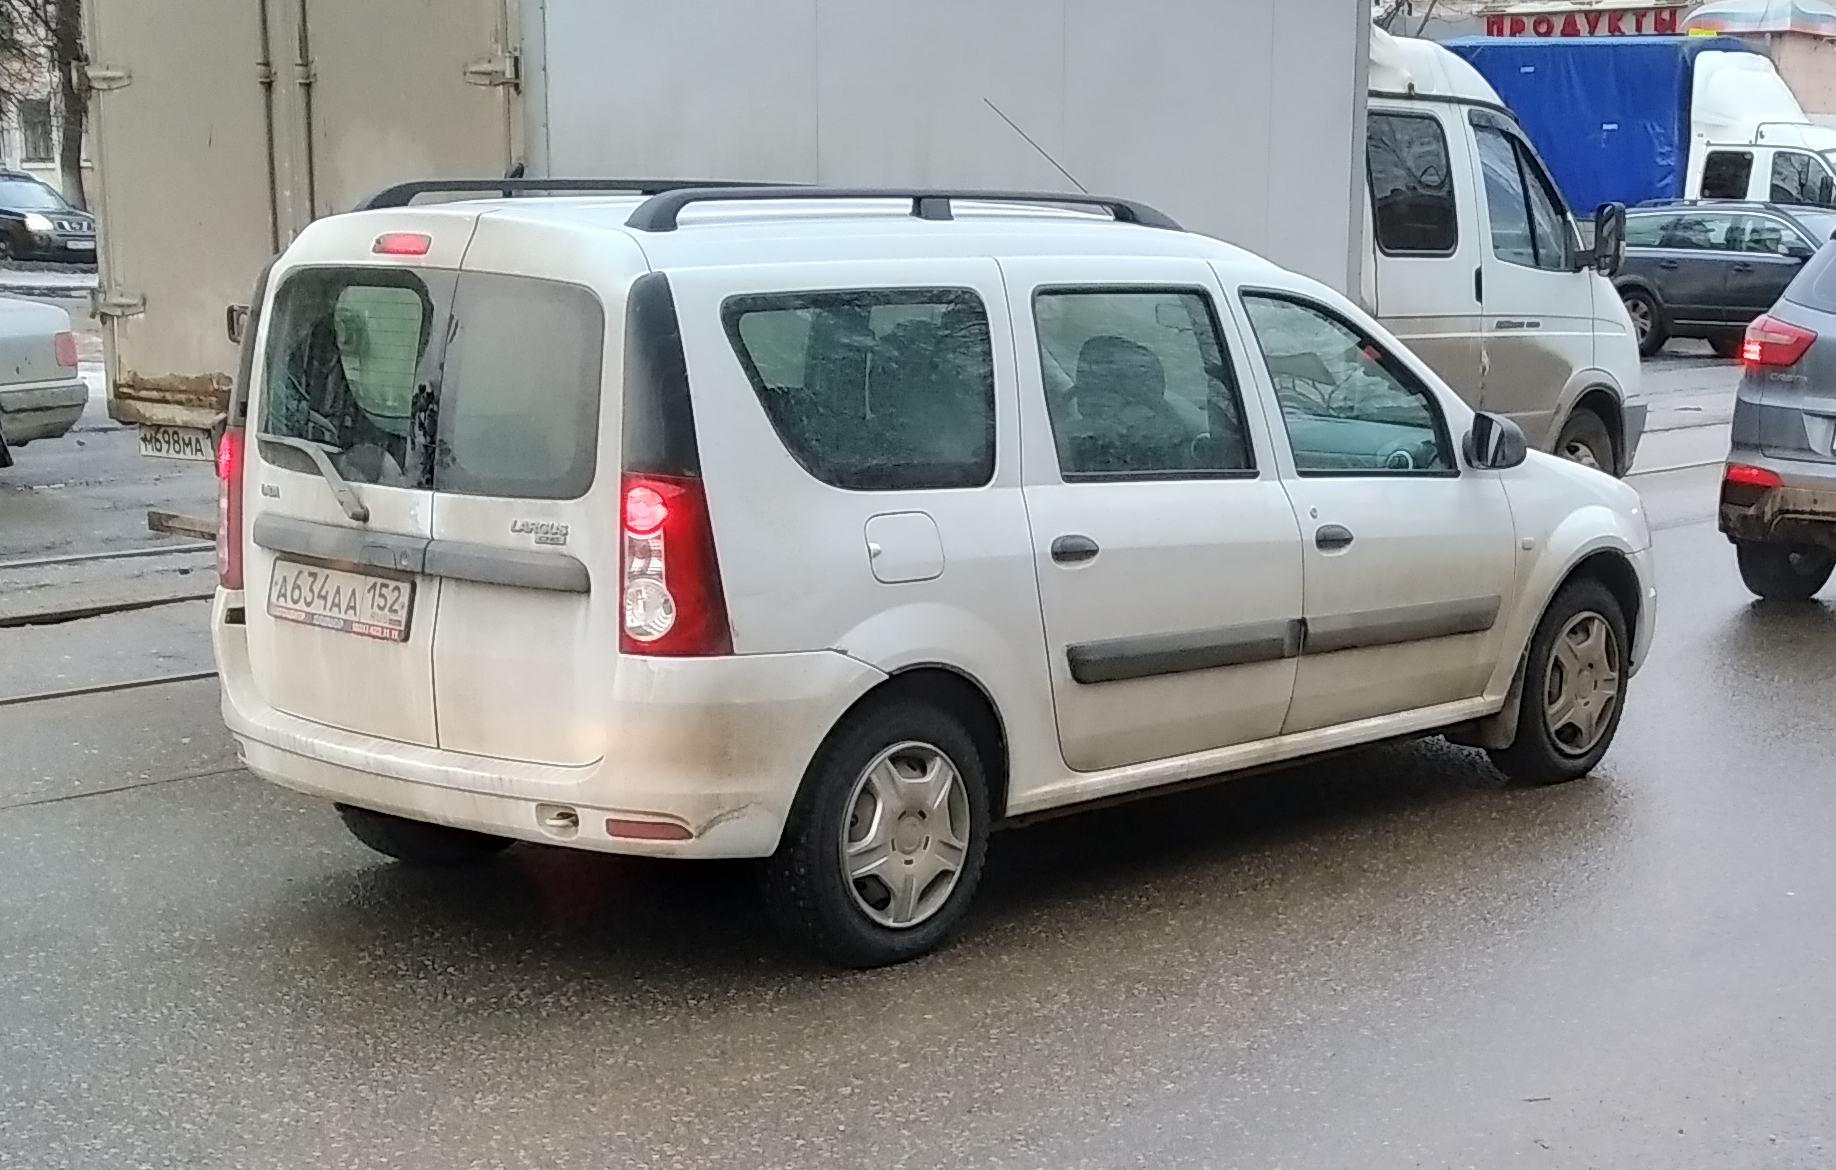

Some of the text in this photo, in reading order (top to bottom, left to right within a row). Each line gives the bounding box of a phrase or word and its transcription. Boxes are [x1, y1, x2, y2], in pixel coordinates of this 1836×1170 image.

[1486, 9, 1677, 37] ПРОДУКТЫ
[510, 519, 569, 536] LARGUS
[276, 570, 402, 616] А634АА 152
